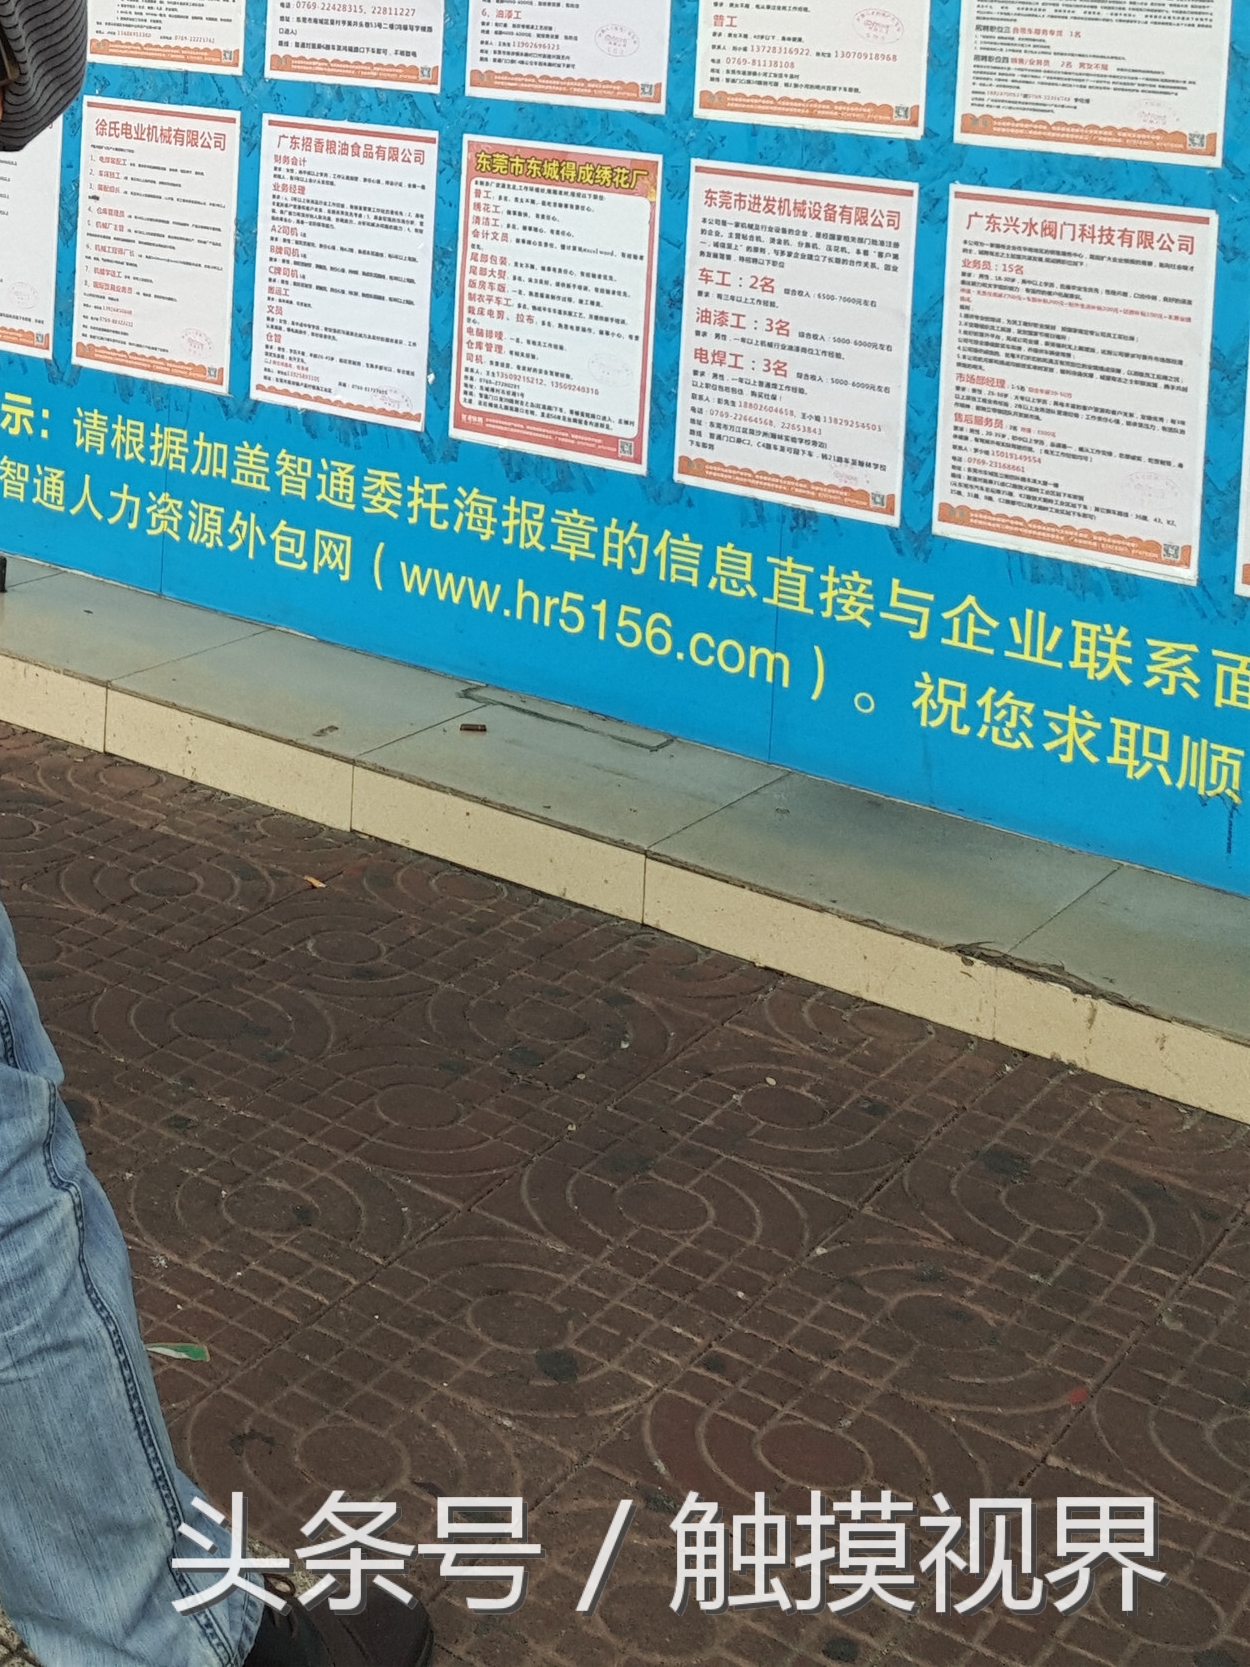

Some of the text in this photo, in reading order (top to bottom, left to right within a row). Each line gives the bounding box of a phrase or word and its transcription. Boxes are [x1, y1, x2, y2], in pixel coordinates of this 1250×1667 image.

[713, 14, 738, 28] 普工
[95, 118, 227, 151] 徐氏电业机械有限公司
[475, 151, 648, 189] 东莞市东城得成绣花厂
[703, 188, 901, 230] 东莞市进发机械设备有限公司
[966, 211, 1195, 255] 广东兴水阀门科技有限公司
[698, 267, 776, 294] 车工：2名
[961, 258, 1024, 275] 业务员：15名
[695, 307, 791, 337] 油漆工：3名
[693, 347, 789, 378] 电焊工：3名
[74, 406, 1250, 709] 请根据加盖智通委托海报章的信息直接与企业联系面
